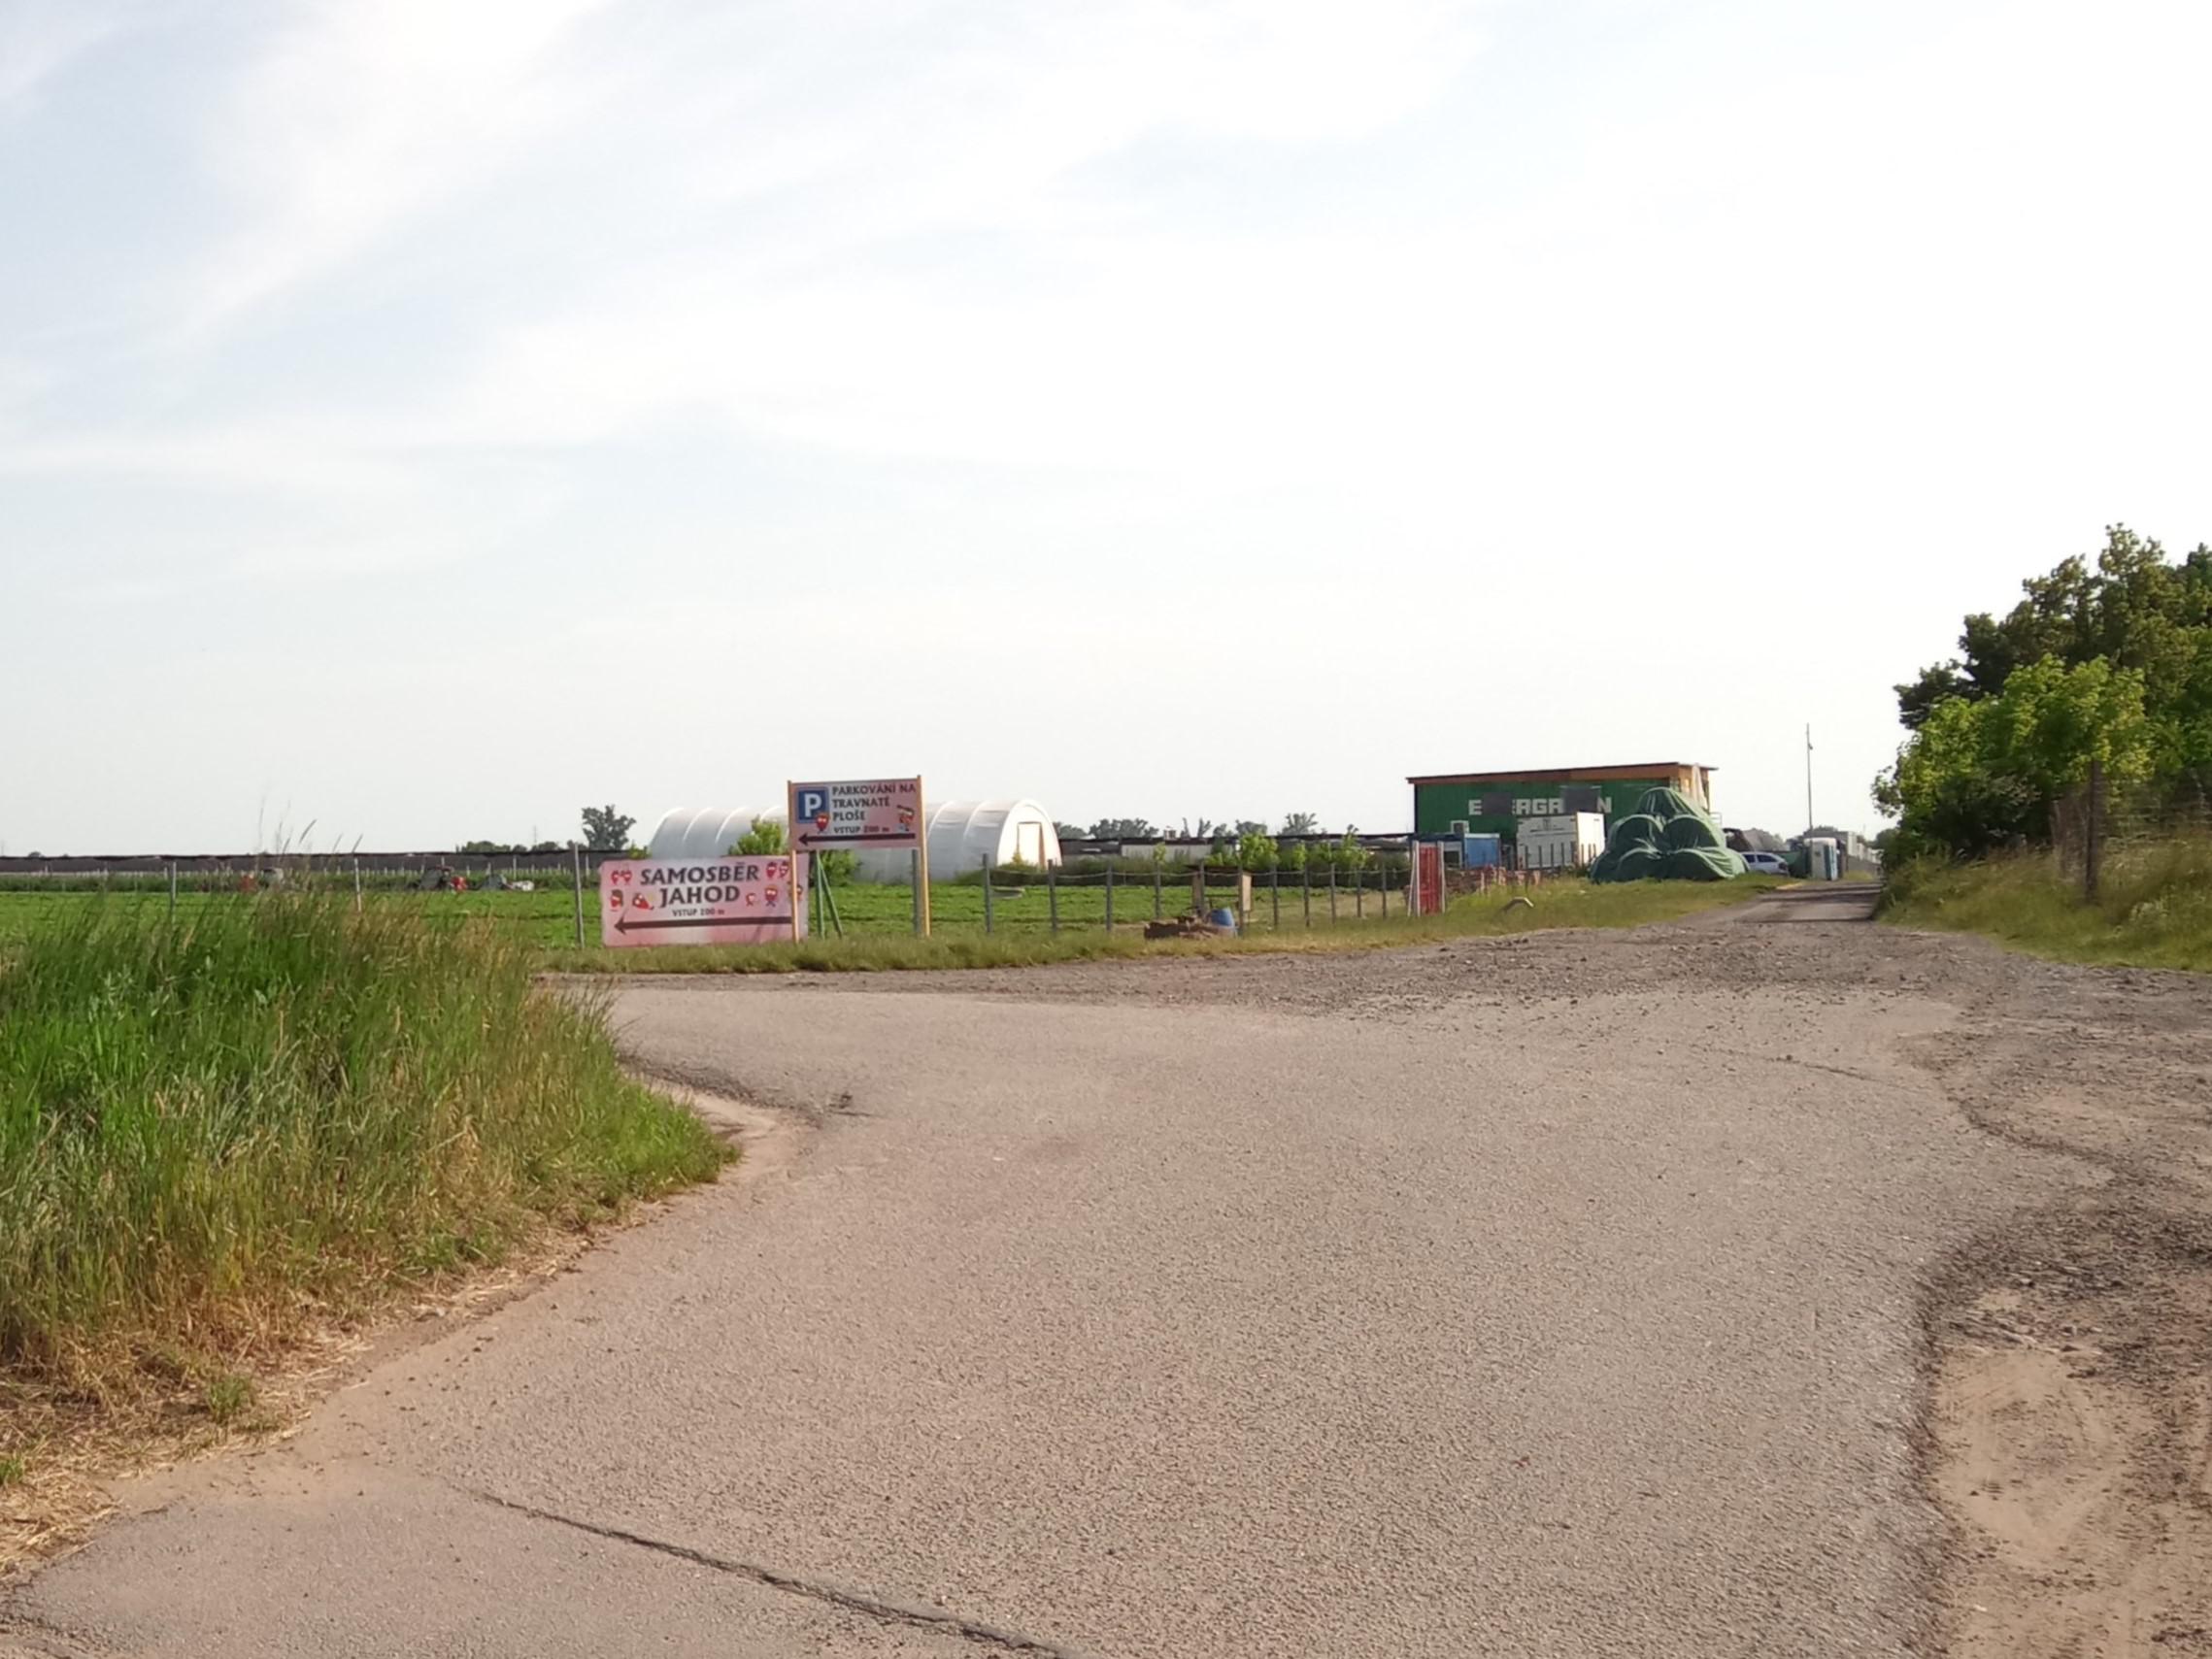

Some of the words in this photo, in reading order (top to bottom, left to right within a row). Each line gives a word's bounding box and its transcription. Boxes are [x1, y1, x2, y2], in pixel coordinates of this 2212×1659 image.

[899, 783, 916, 793] NA
[804, 793, 822, 817] P
[1468, 797, 1612, 814] ERGRN
[832, 811, 865, 821] PLOŠE
[833, 825, 861, 834] VSTUP
[640, 862, 759, 885] SAMOSBĚR
[659, 885, 740, 908] JAHOD
[672, 908, 698, 917] VSTUP
